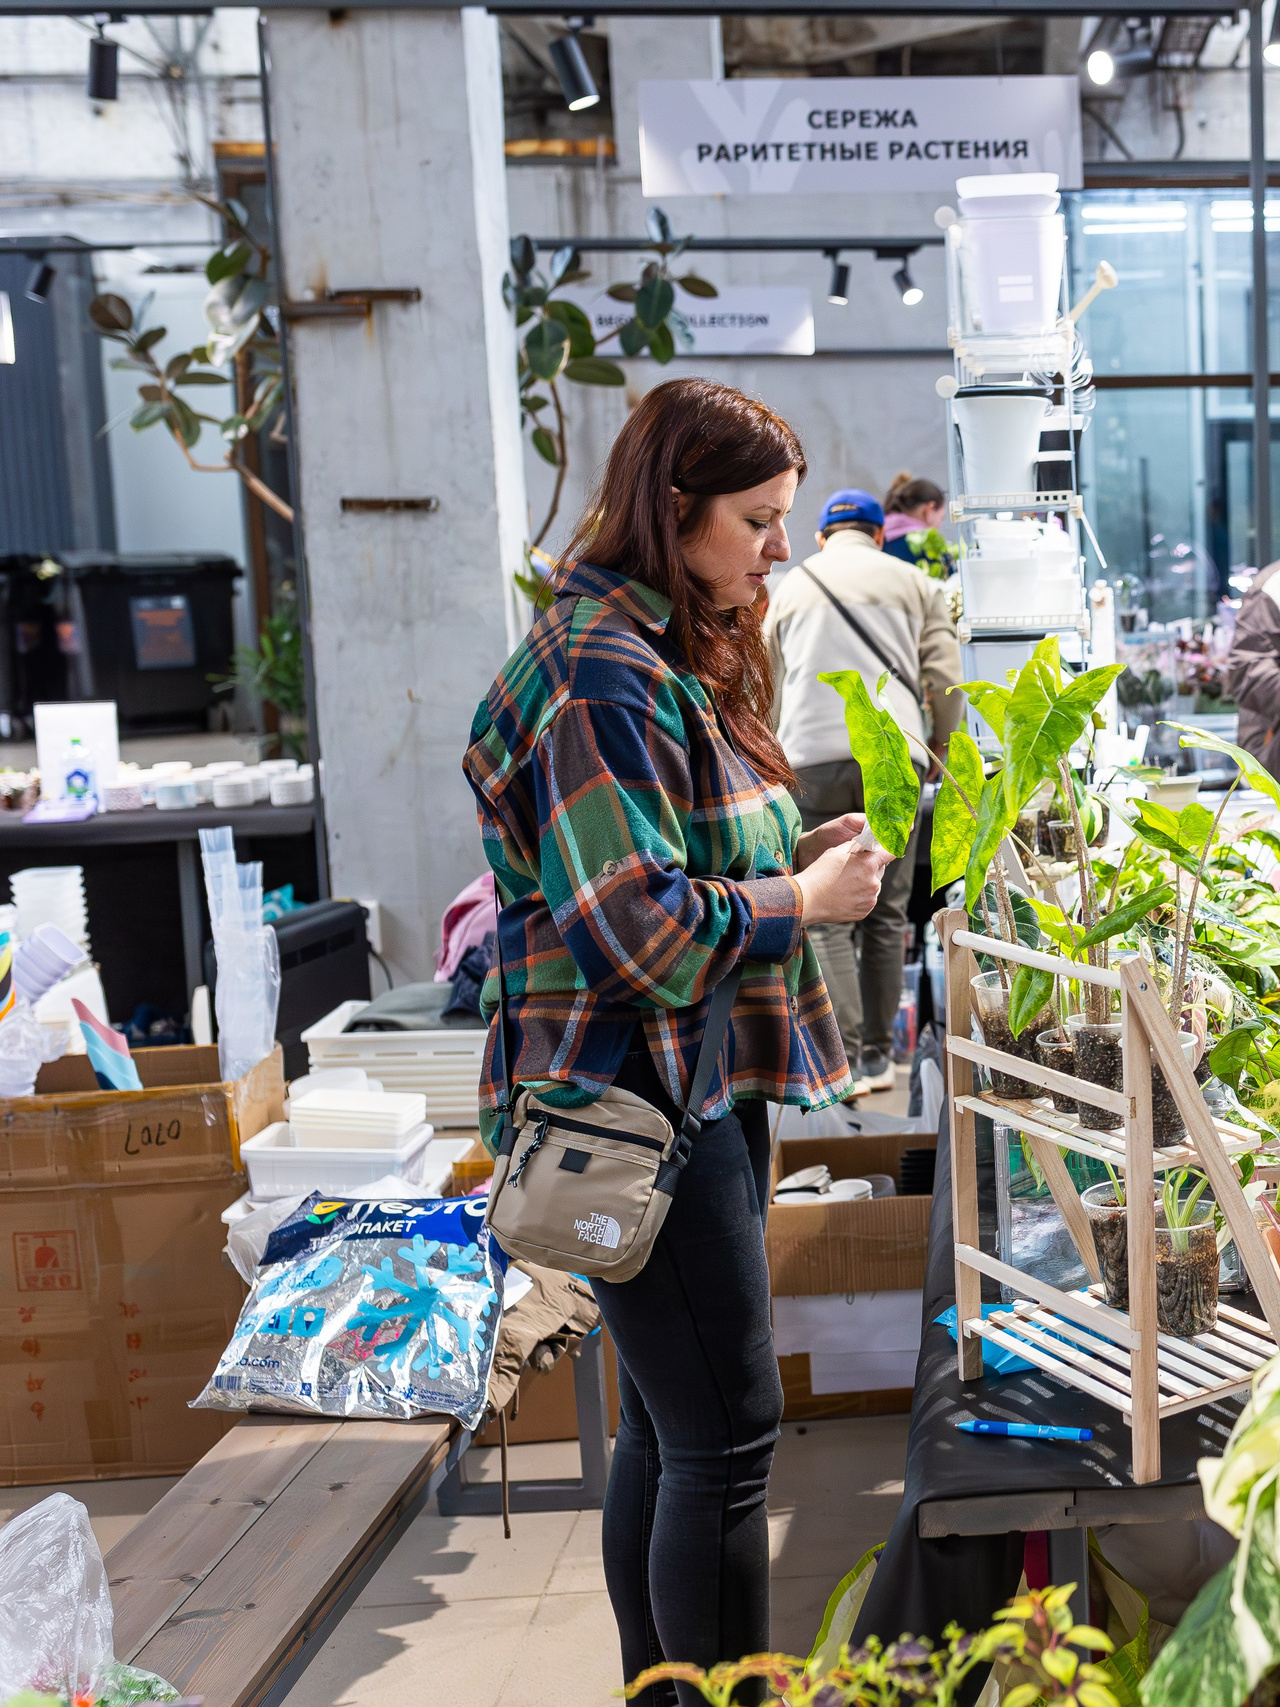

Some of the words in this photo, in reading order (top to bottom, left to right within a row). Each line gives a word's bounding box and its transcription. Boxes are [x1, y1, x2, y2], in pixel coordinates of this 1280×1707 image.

[807, 109, 918, 130] СЕРЕЖА
[697, 141, 879, 163] РАРИТЕТНЫЕ
[888, 139, 1029, 161] РАСТЕНИЯ
[682, 313, 770, 328] LLECTION
[573, 1219, 606, 1236] NORTH
[590, 1212, 609, 1226] THE
[309, 1219, 417, 1252] ТЕРОПАКЕТ
[577, 1230, 602, 1245] FACE
